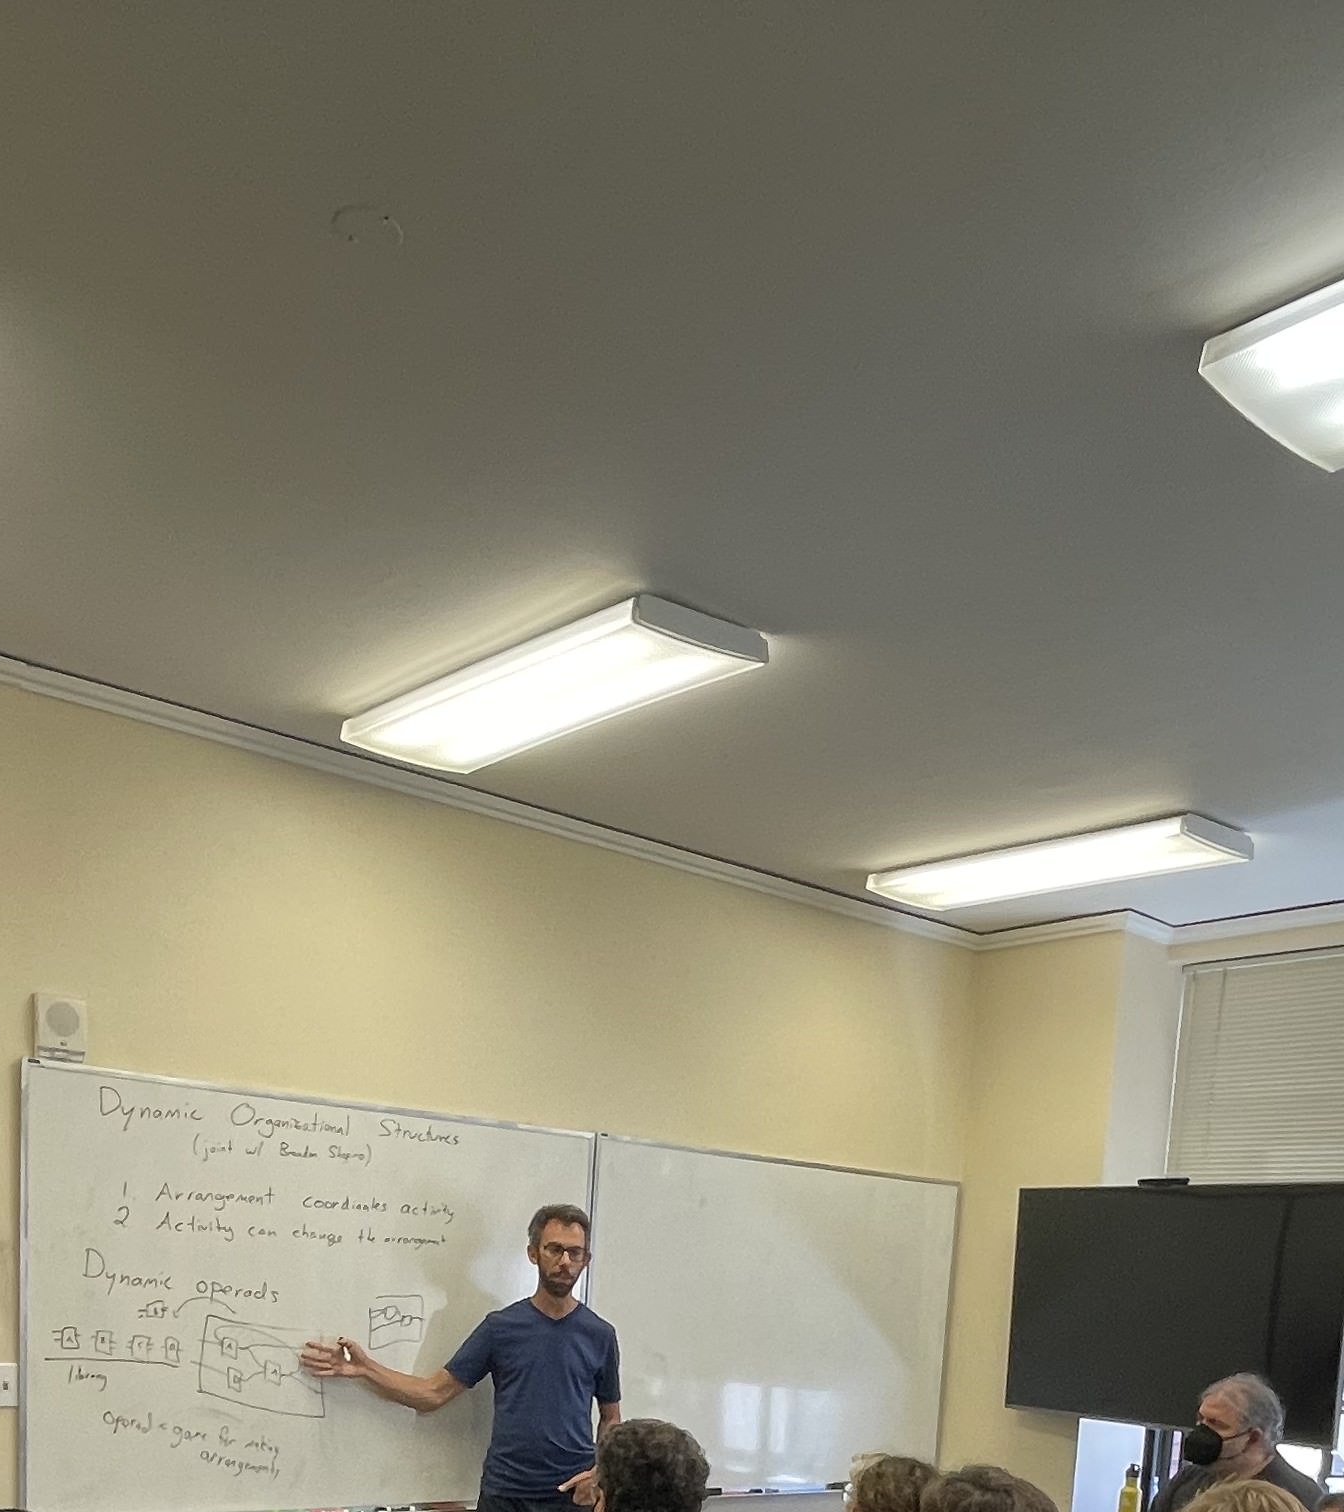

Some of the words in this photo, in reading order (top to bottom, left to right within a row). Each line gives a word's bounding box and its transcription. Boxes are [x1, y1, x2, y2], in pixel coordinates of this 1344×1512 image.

[99, 1085, 204, 1131] Dynamic
[230, 1102, 350, 1138] Organizational
[155, 1182, 276, 1211] Arrangement
[400, 1201, 455, 1225] activity
[155, 1211, 235, 1242] Activity
[247, 1225, 278, 1238] can
[292, 1224, 343, 1248] change
[82, 1247, 174, 1296] Dynamic
